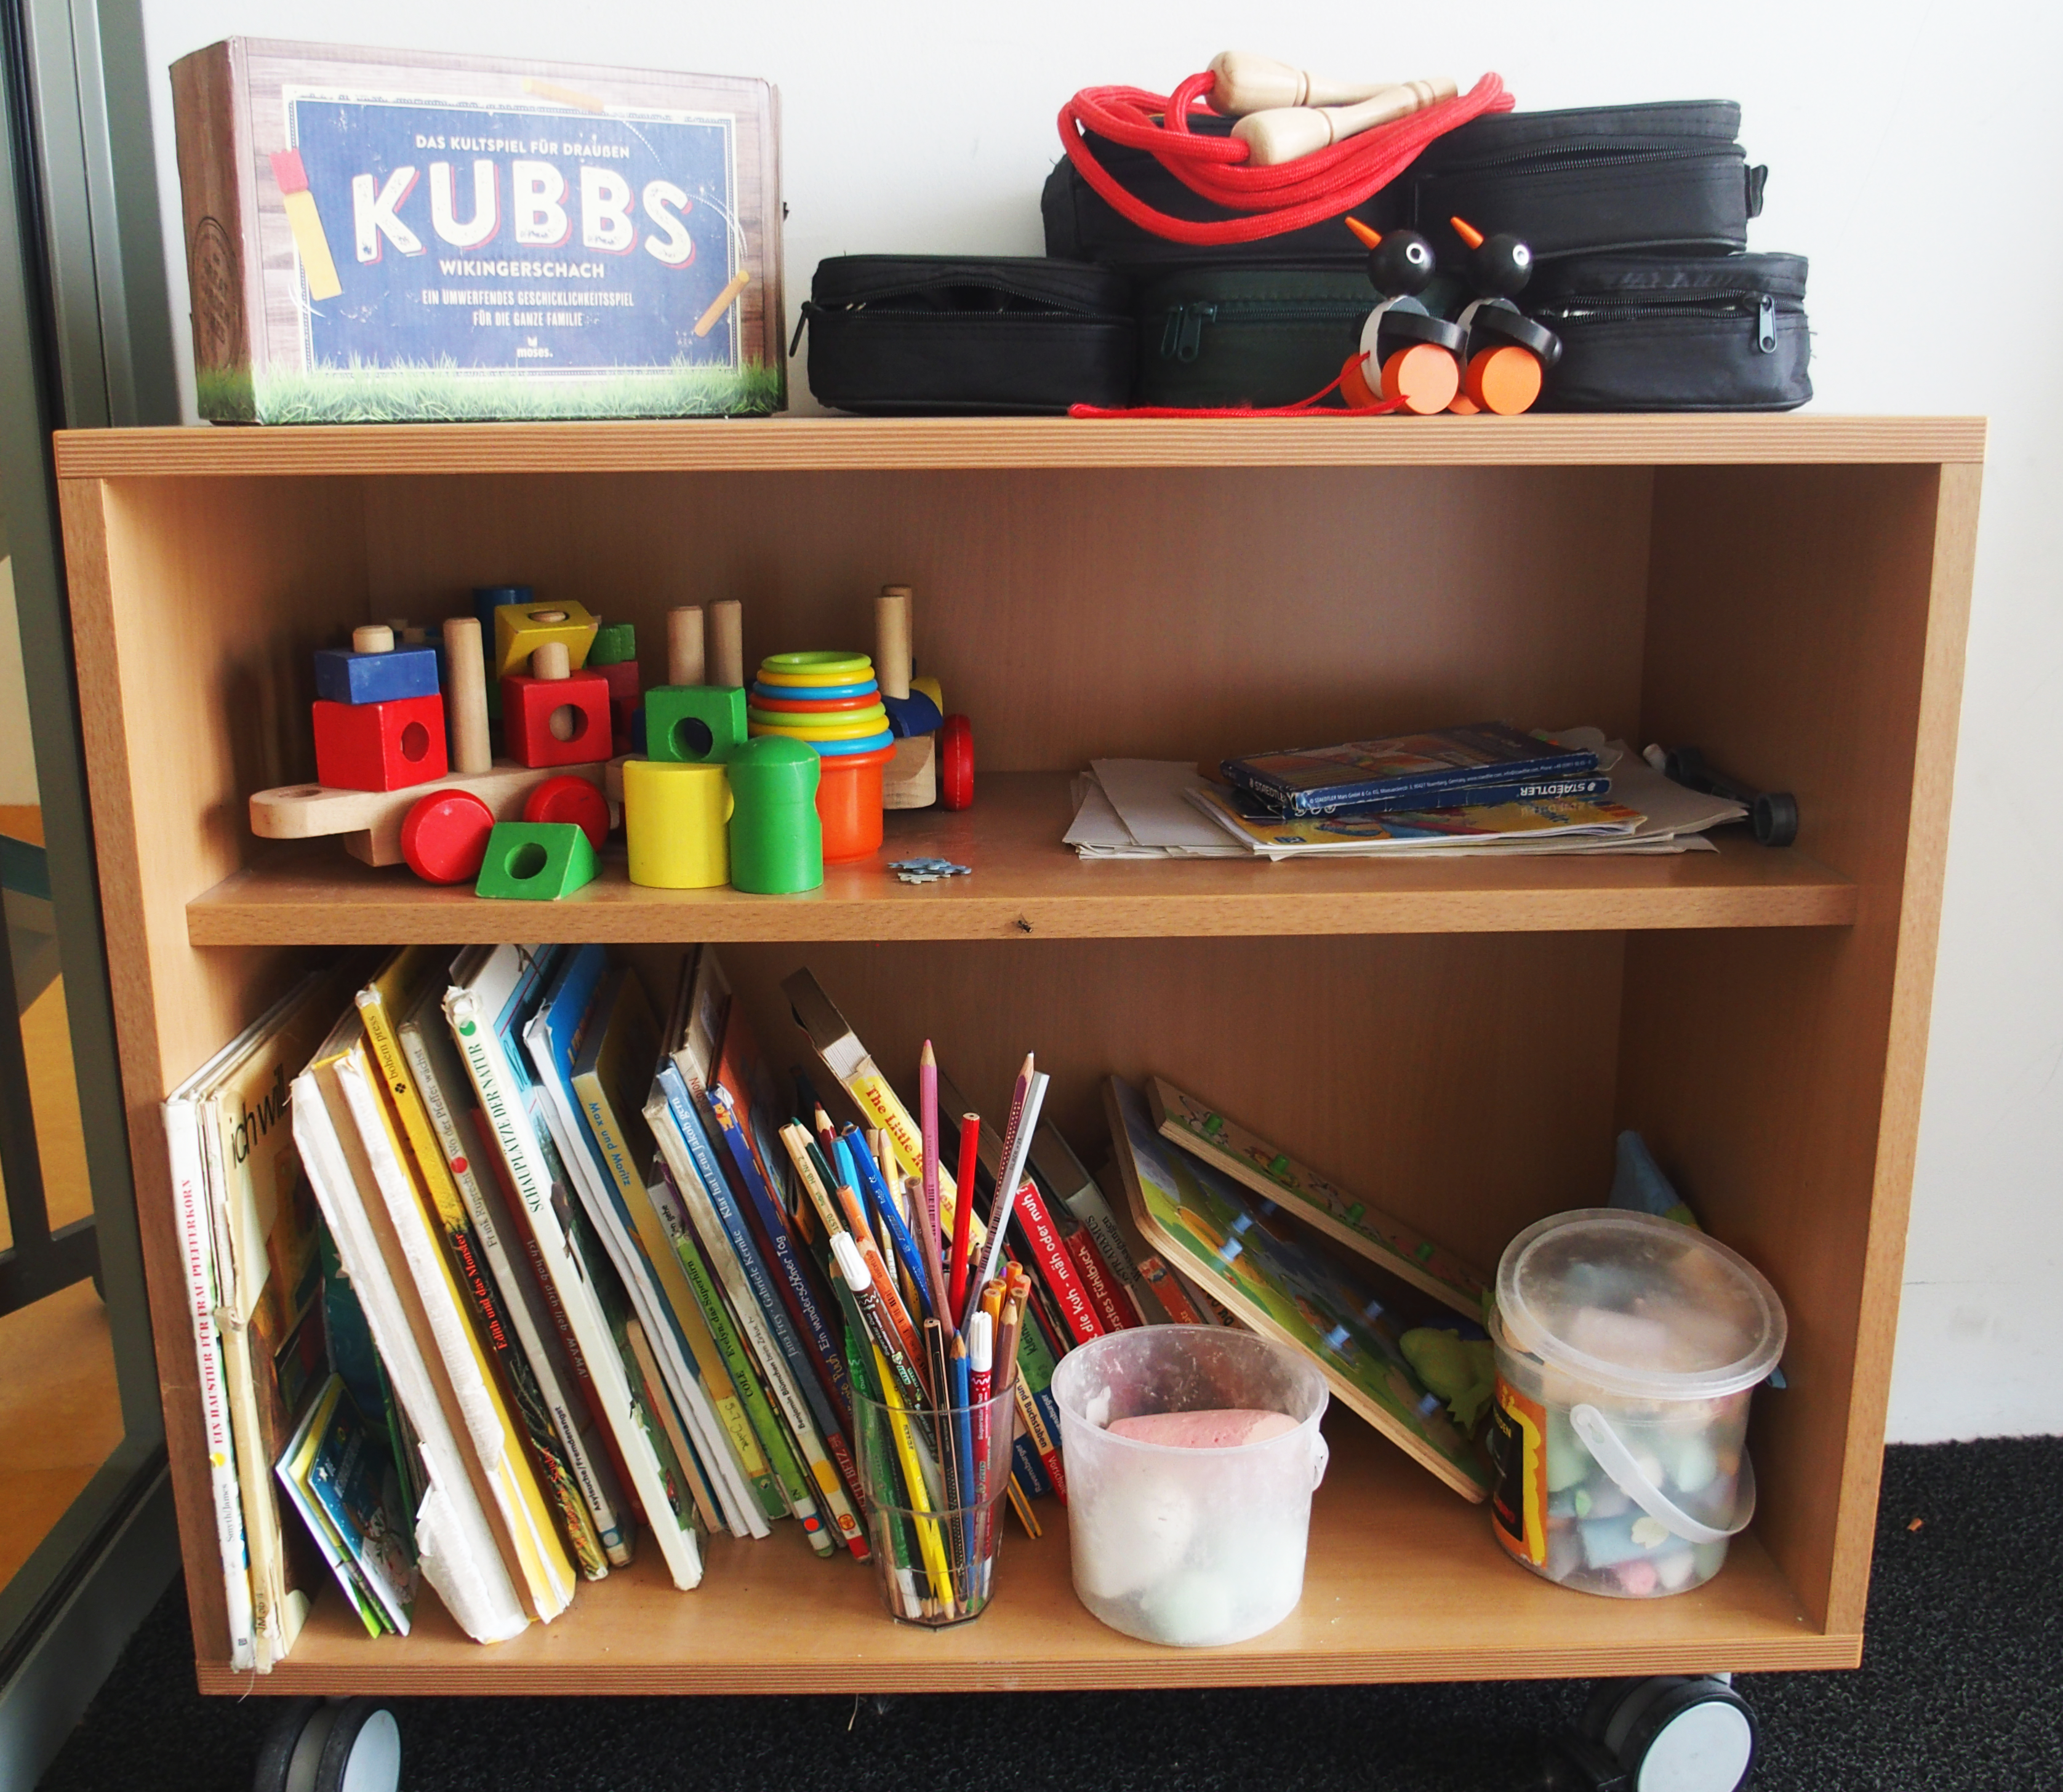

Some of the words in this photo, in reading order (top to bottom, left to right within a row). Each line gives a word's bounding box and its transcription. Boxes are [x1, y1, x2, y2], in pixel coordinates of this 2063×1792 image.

[415, 135, 446, 150] DAS
[451, 137, 527, 153] KULTSPIEL
[531, 139, 558, 154] FÜR
[352, 159, 696, 267] KUBBS
[440, 259, 604, 278] WIKINGERSCHACH
[422, 290, 439, 305] EIN
[442, 289, 515, 306] UMWERFENDES
[518, 292, 634, 307] GESCHICKLICHKEITSSPIEL
[473, 310, 492, 327] FÜR
[495, 312, 511, 327] DIE
[513, 312, 544, 327] GANZE
[547, 313, 583, 327] FAMILIE
[1520, 783, 1586, 798] STAEDTLER
[369, 1015, 388, 1042] press
[380, 1044, 398, 1079] bohem
[414, 1048, 432, 1083] wächst
[468, 1042, 497, 1090] NATUR
[429, 1084, 447, 1120] Pfeffer
[486, 1090, 507, 1119] DER
[671, 1097, 691, 1120] gern
[230, 1102, 258, 1169] ich
[440, 1116, 454, 1134] der
[681, 1121, 705, 1153] Jakob
[866, 1085, 886, 1114] The
[884, 1115, 913, 1153] Little
[911, 1153, 924, 1173] Re
[447, 1131, 460, 1157] Wo
[588, 1102, 604, 1127] Max
[601, 1129, 618, 1151] und
[611, 1153, 631, 1186] Moritz
[496, 1119, 545, 1214] SCHAUPLÄTZE
[697, 1152, 713, 1179] Lena
[802, 1163, 811, 1174] Nr.
[806, 1174, 816, 1185] HB
[708, 1178, 722, 1196] hat
[1015, 1186, 1028, 1195] ?
[718, 1196, 732, 1219] Klar
[1021, 1194, 1043, 1222] muh
[182, 1179, 202, 1277] PFEFFERKORN
[827, 1213, 839, 1231] 1570
[734, 1230, 754, 1266] Kernke
[775, 1235, 787, 1257] Tag
[1036, 1224, 1056, 1252] oder
[1102, 1215, 1143, 1283] Weissagungen
[455, 1233, 478, 1278] Monster
[1049, 1252, 1070, 1280] mäh
[527, 1239, 537, 1257] Ich
[535, 1258, 548, 1281] hab
[544, 1284, 559, 1307] dich
[687, 1261, 714, 1309] Superhirn
[1078, 1245, 1108, 1299] Fühlbuch
[195, 1283, 208, 1316] FRAU
[475, 1278, 487, 1297] das
[750, 1266, 774, 1308] Gabriele
[783, 1256, 823, 1332] wunderschöner
[479, 1298, 495, 1319] und
[707, 1306, 720, 1324] das
[1065, 1289, 1084, 1315] Kuh
[197, 1321, 212, 1348] FÜR
[489, 1320, 508, 1350] Edith
[771, 1313, 787, 1335] Frey
[1079, 1314, 1094, 1334] die
[763, 1345, 773, 1362] beim
[783, 1335, 799, 1358] Jana
[818, 1330, 830, 1351] Ein
[770, 1362, 790, 1396] Blümchen
[825, 1353, 846, 1383] Puuh
[202, 1354, 220, 1418] HAUSTIER
[736, 1370, 754, 1398] COLE
[787, 1395, 806, 1430] Benjamin
[1017, 1383, 1029, 1400] und
[1024, 1401, 1047, 1448] Buchstaben
[213, 1423, 224, 1444] EIN
[555, 1405, 601, 1511] Asylsuche/Fremdenangst
[835, 1450, 857, 1479] BETZ
[1015, 1444, 1042, 1494] Ravensburger
[222, 1484, 234, 1542] Smyth/James
